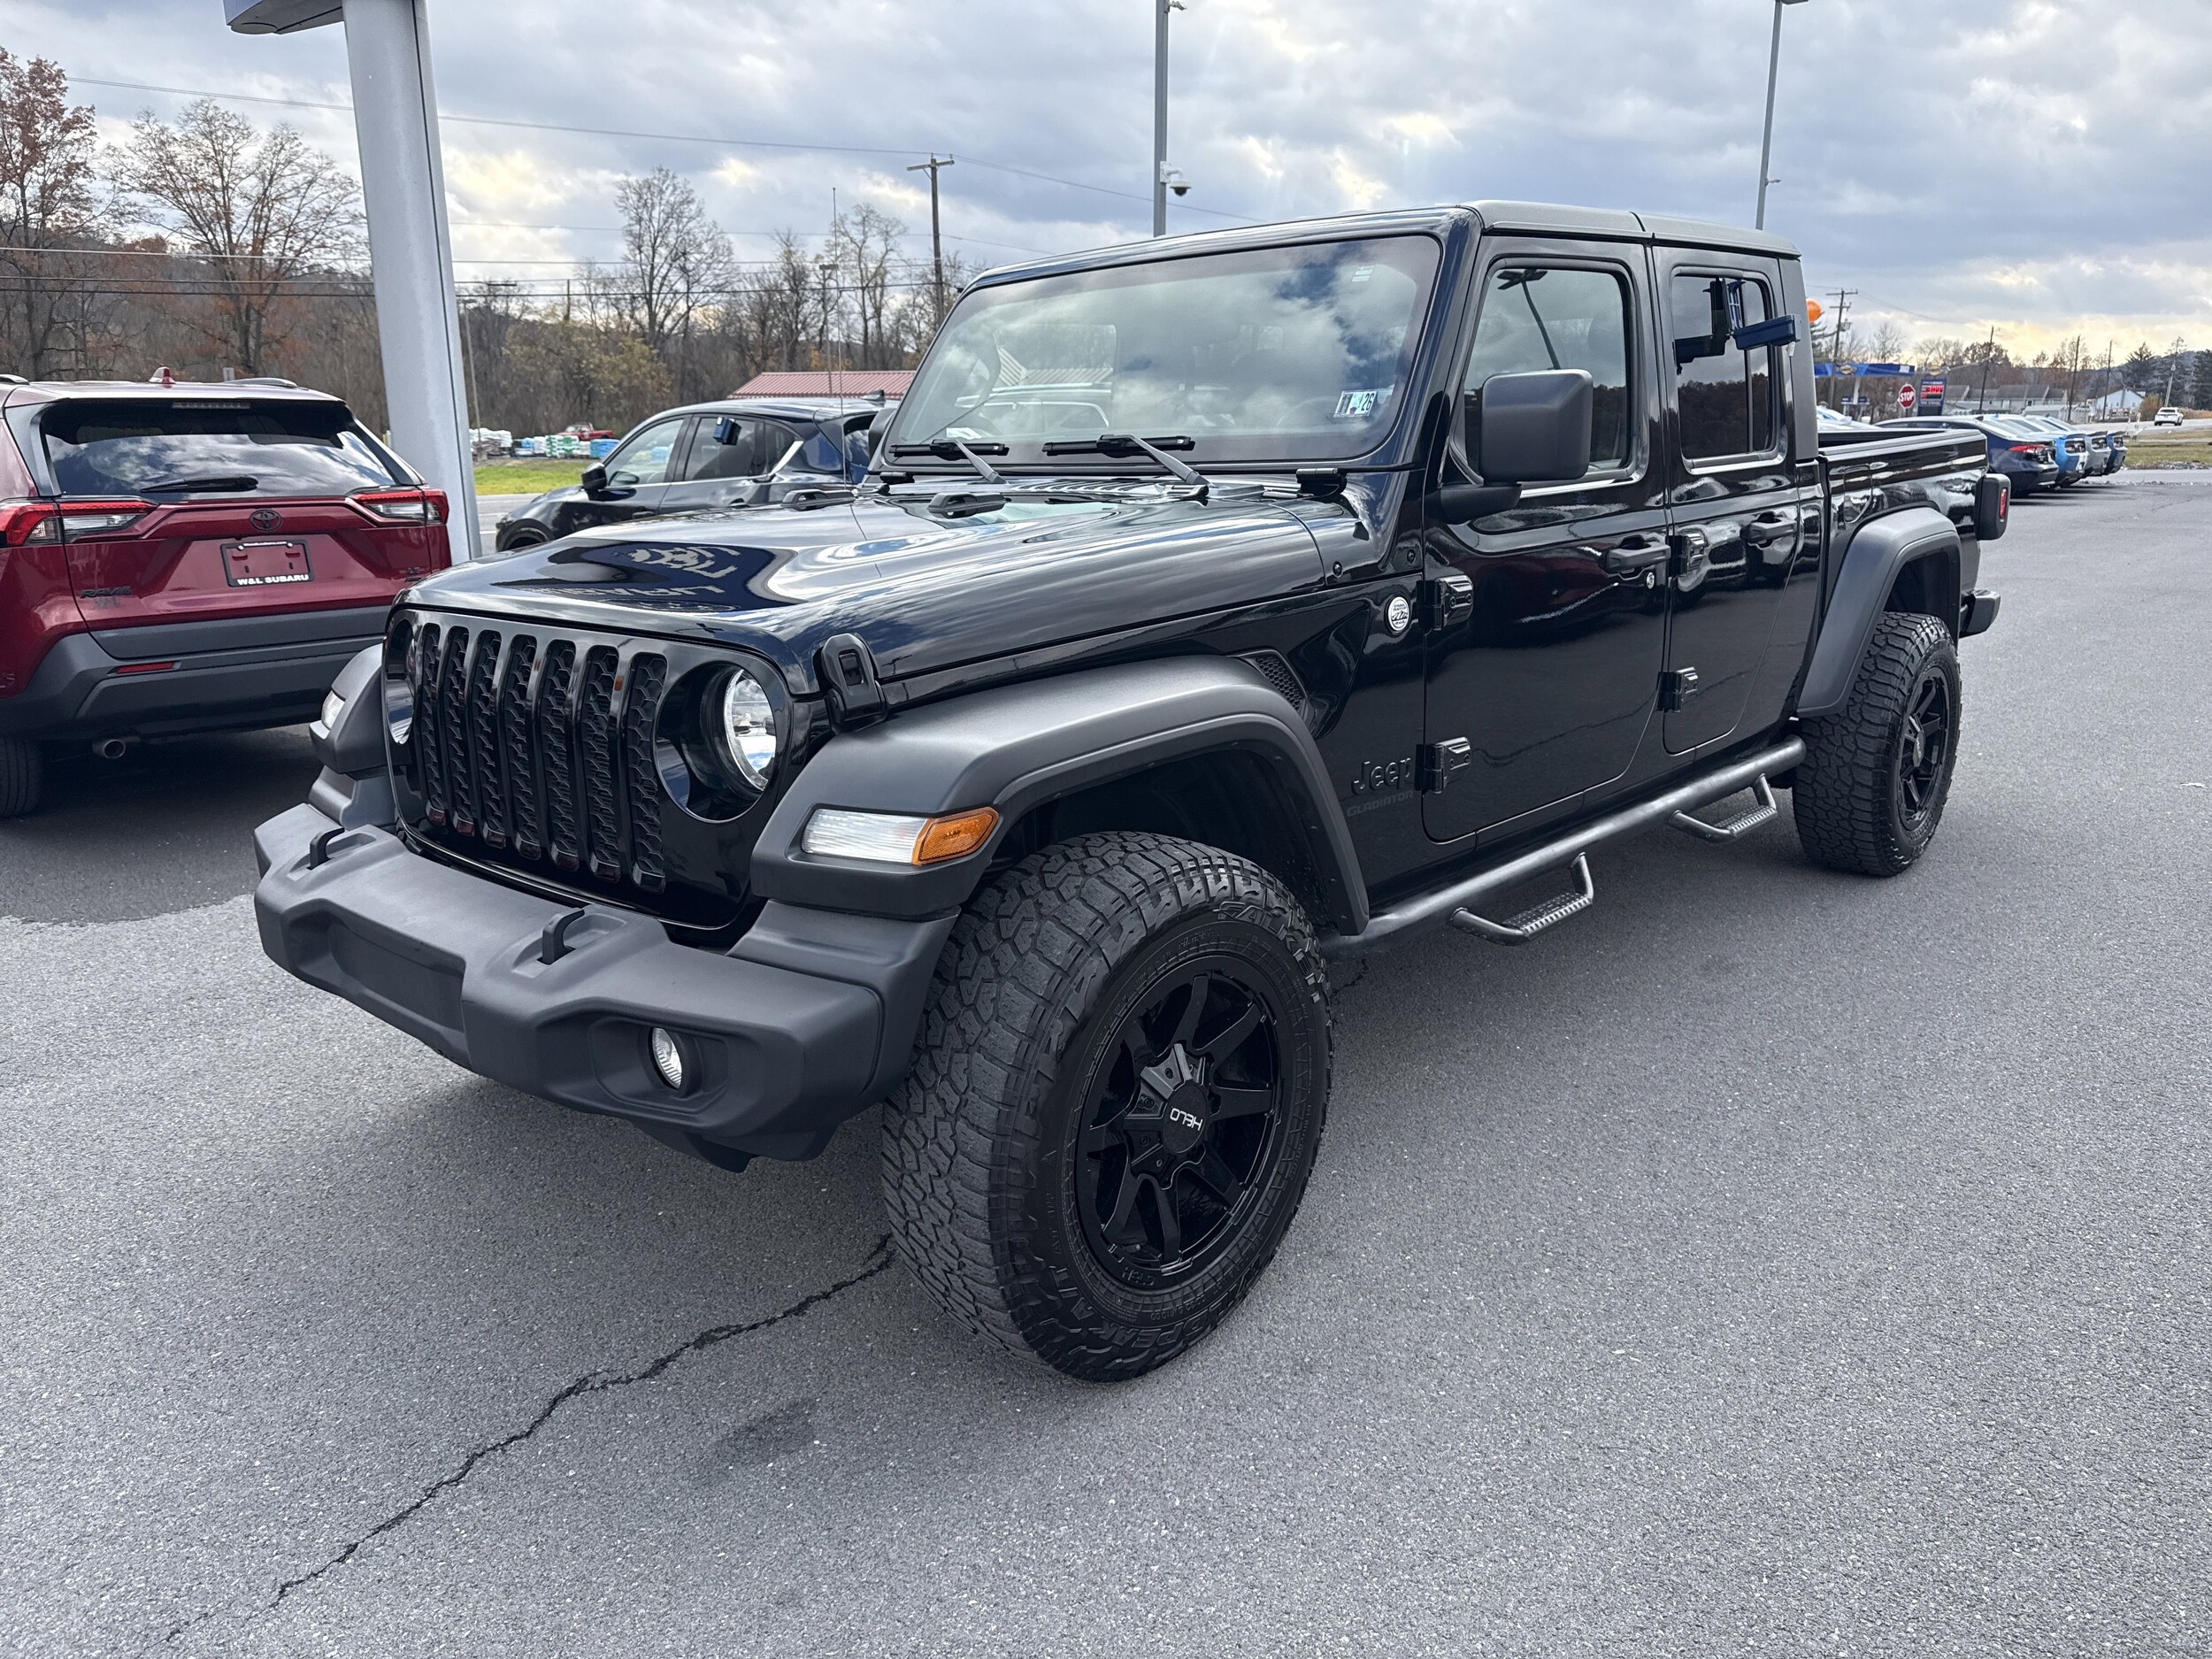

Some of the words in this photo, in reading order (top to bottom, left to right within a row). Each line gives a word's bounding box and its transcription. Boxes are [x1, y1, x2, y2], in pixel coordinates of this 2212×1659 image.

[1361, 393, 1375, 411] 26
[1900, 391, 1915, 402] STOP
[265, 574, 310, 584] SUBARU
[1351, 757, 1412, 795] Jeep
[1346, 789, 1414, 818] GLADIATOR
[1170, 1107, 1203, 1131] HELO
